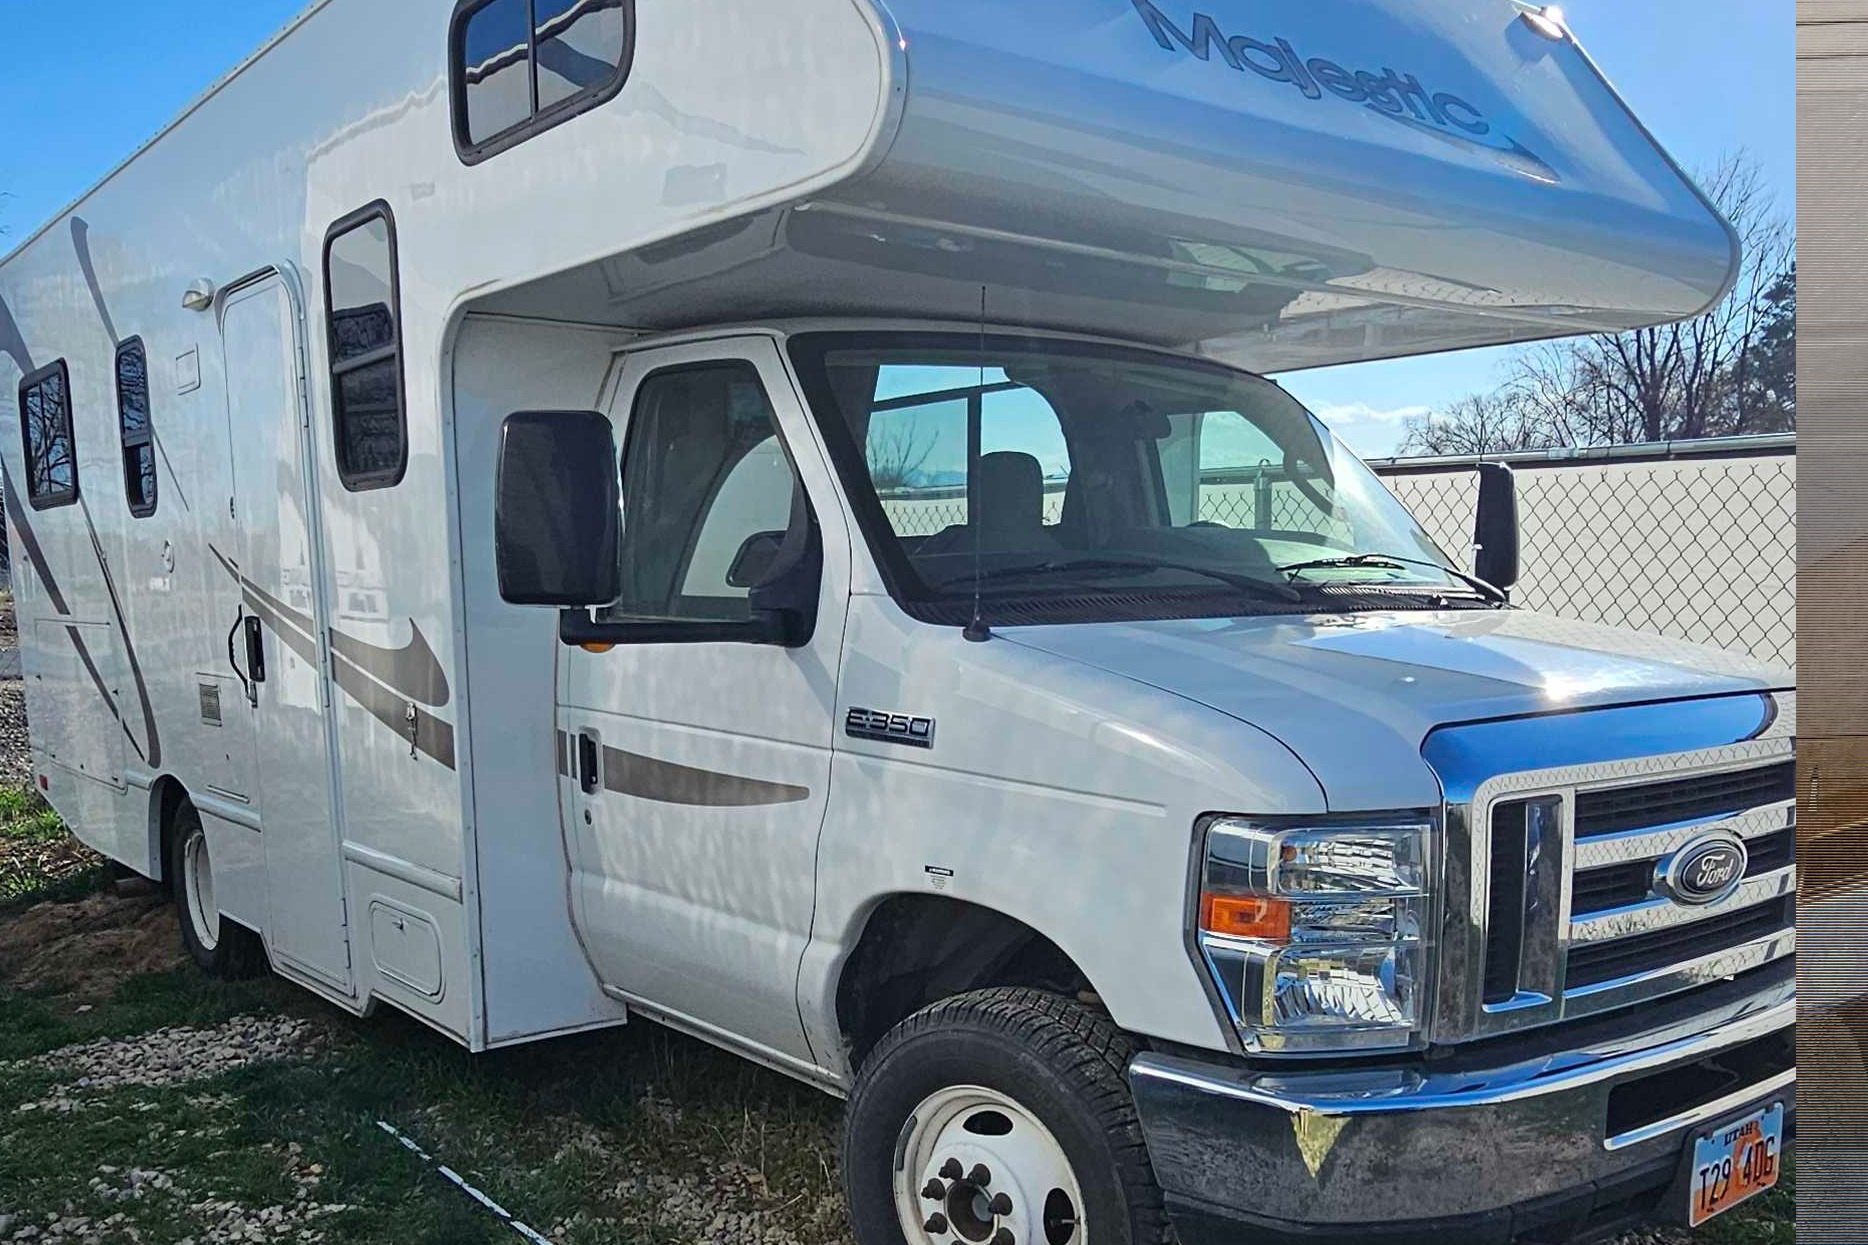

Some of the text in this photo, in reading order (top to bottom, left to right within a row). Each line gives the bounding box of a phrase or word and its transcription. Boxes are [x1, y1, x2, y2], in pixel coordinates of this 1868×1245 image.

[1131, 0, 1490, 135] Majestic
[1696, 853, 1734, 887] Ford
[1723, 1123, 1753, 1146] UTAH
[1699, 1157, 1732, 1210] T29
